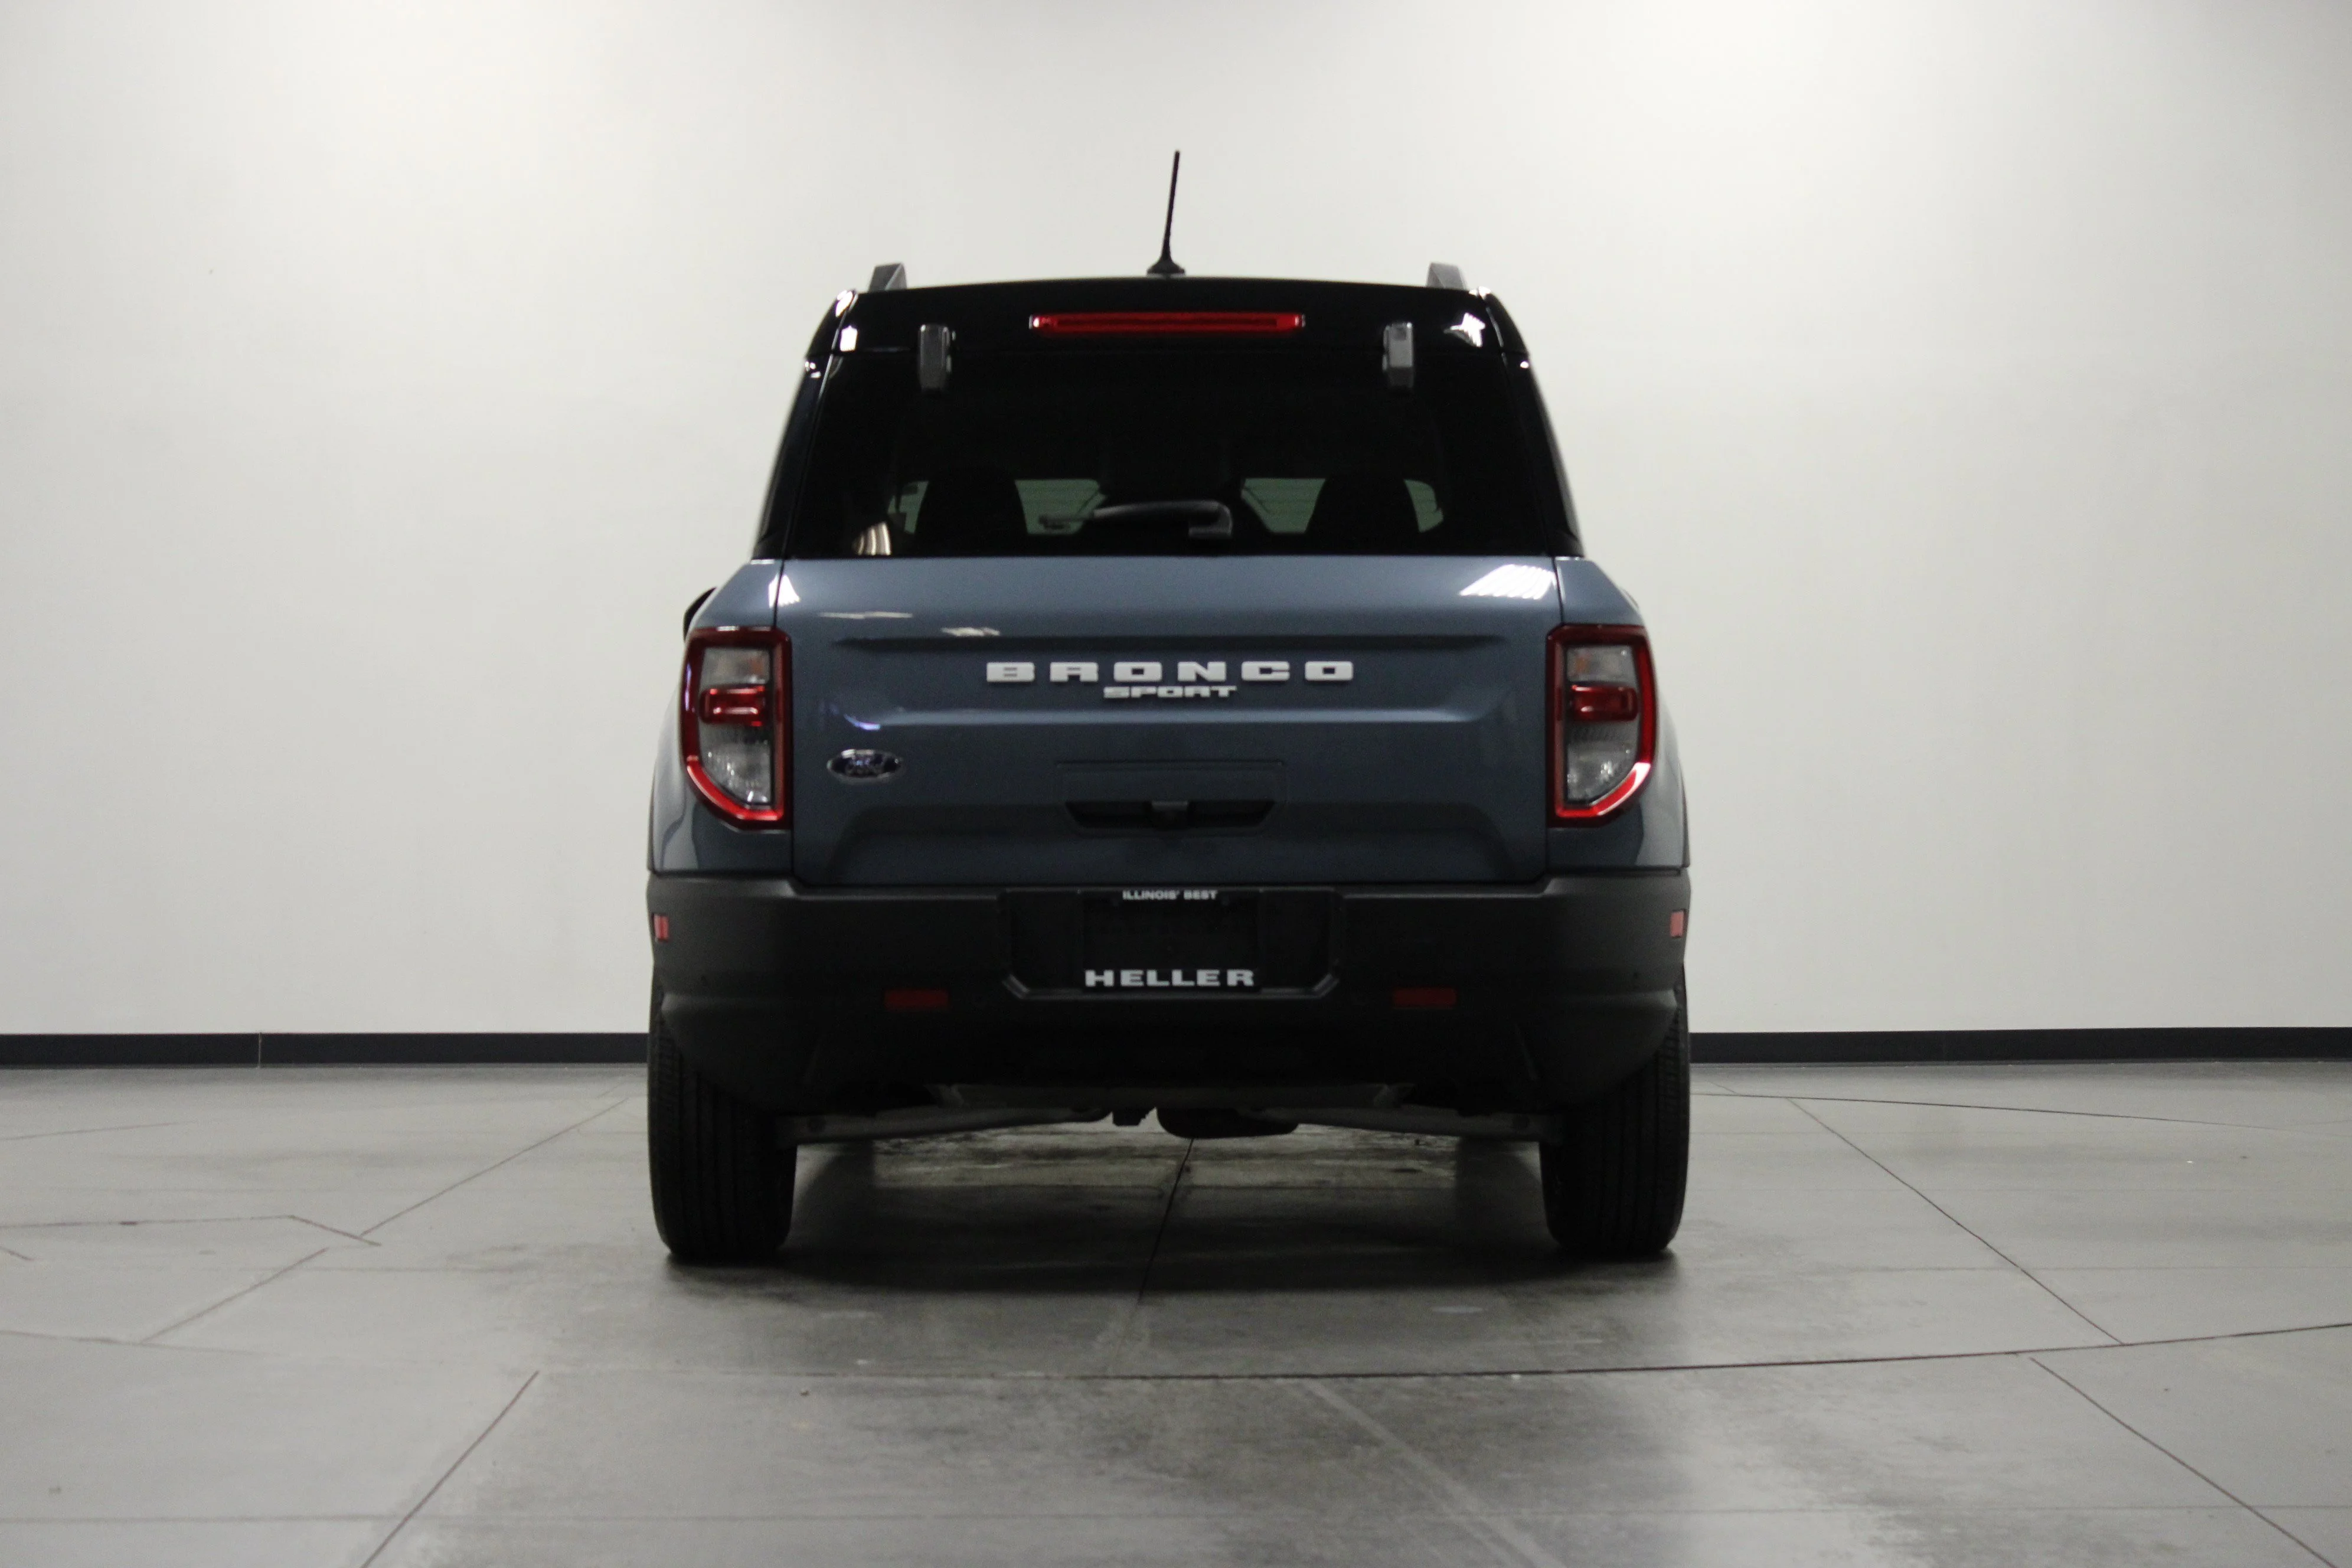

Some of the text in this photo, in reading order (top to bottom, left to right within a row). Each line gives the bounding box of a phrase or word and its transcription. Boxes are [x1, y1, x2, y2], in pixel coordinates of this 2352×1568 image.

[986, 661, 1354, 682] BRONCO
[1103, 685, 1237, 698] SPORT
[1183, 889, 1218, 900] BEST
[1084, 969, 1255, 987] HELLER
